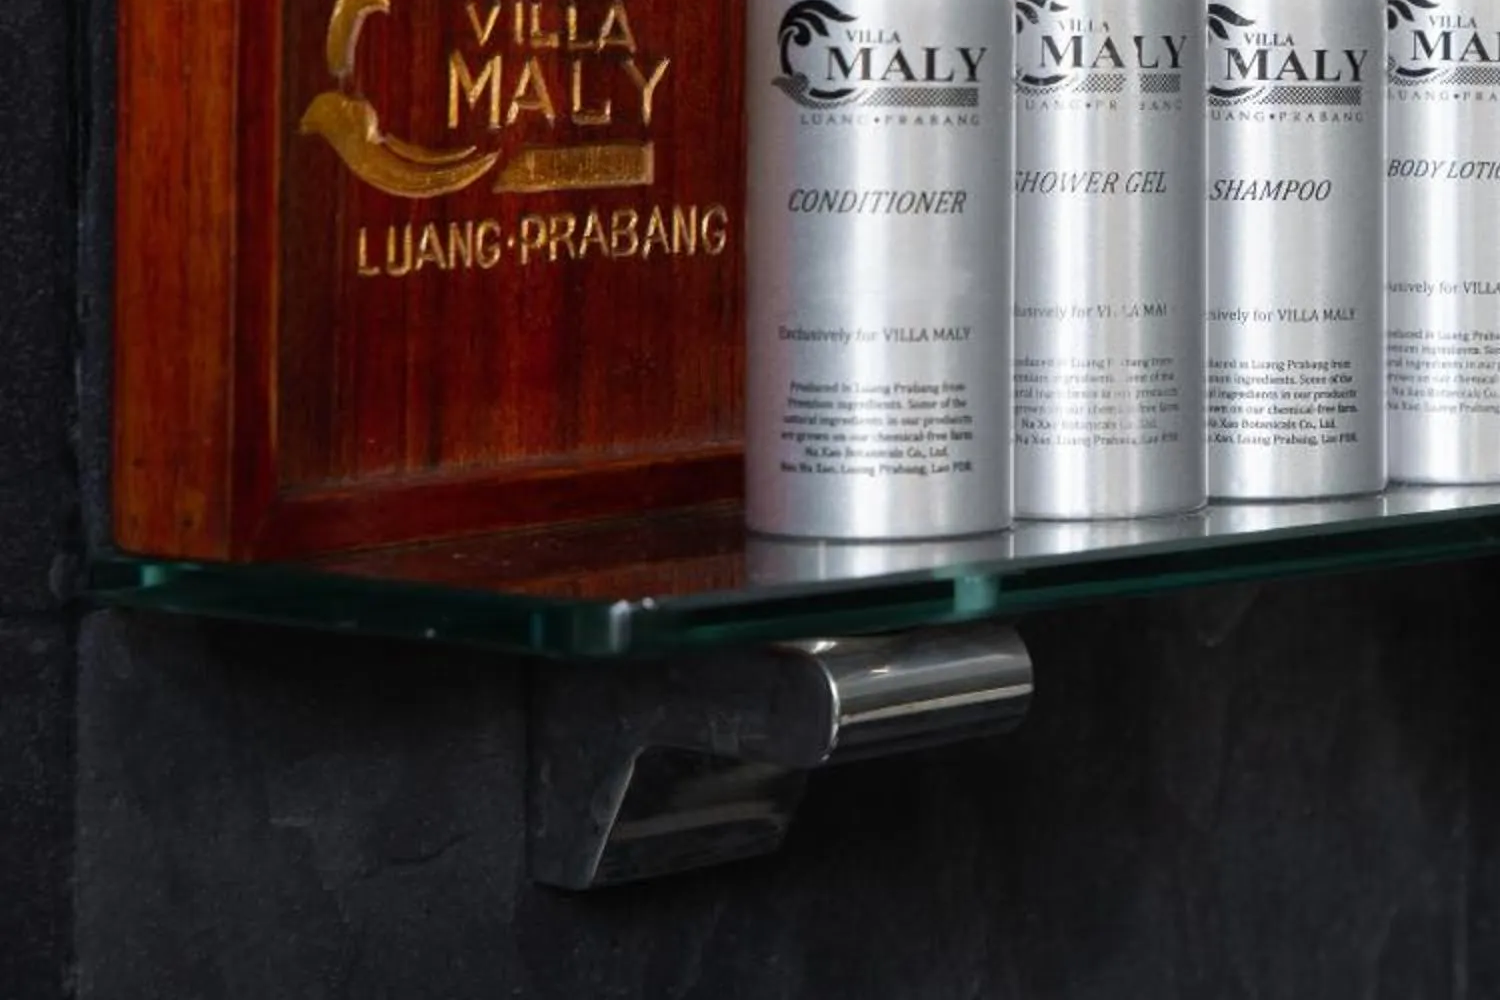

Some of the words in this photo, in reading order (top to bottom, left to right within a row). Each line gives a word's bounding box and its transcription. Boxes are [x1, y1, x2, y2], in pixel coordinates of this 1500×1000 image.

[1429, 15, 1478, 29] VILLA
[846, 29, 902, 43] VILLA
[1244, 33, 1294, 46] VILLA
[1038, 35, 1187, 69] MALY
[825, 46, 988, 82] MALY
[1224, 48, 1368, 82] MALY
[446, 50, 671, 129] MALY
[1387, 159, 1444, 179] BODY
[1125, 170, 1167, 194] GEL
[1209, 179, 1332, 201] SHAMPOO
[788, 188, 967, 214] CONDITIONER
[1438, 282, 1458, 294] for
[1253, 308, 1273, 321] for
[1277, 309, 1318, 323] VILLA
[1323, 308, 1355, 321] MALY
[778, 325, 850, 344] Exclusively
[883, 327, 928, 342] VILLA
[933, 326, 972, 341] MALY
